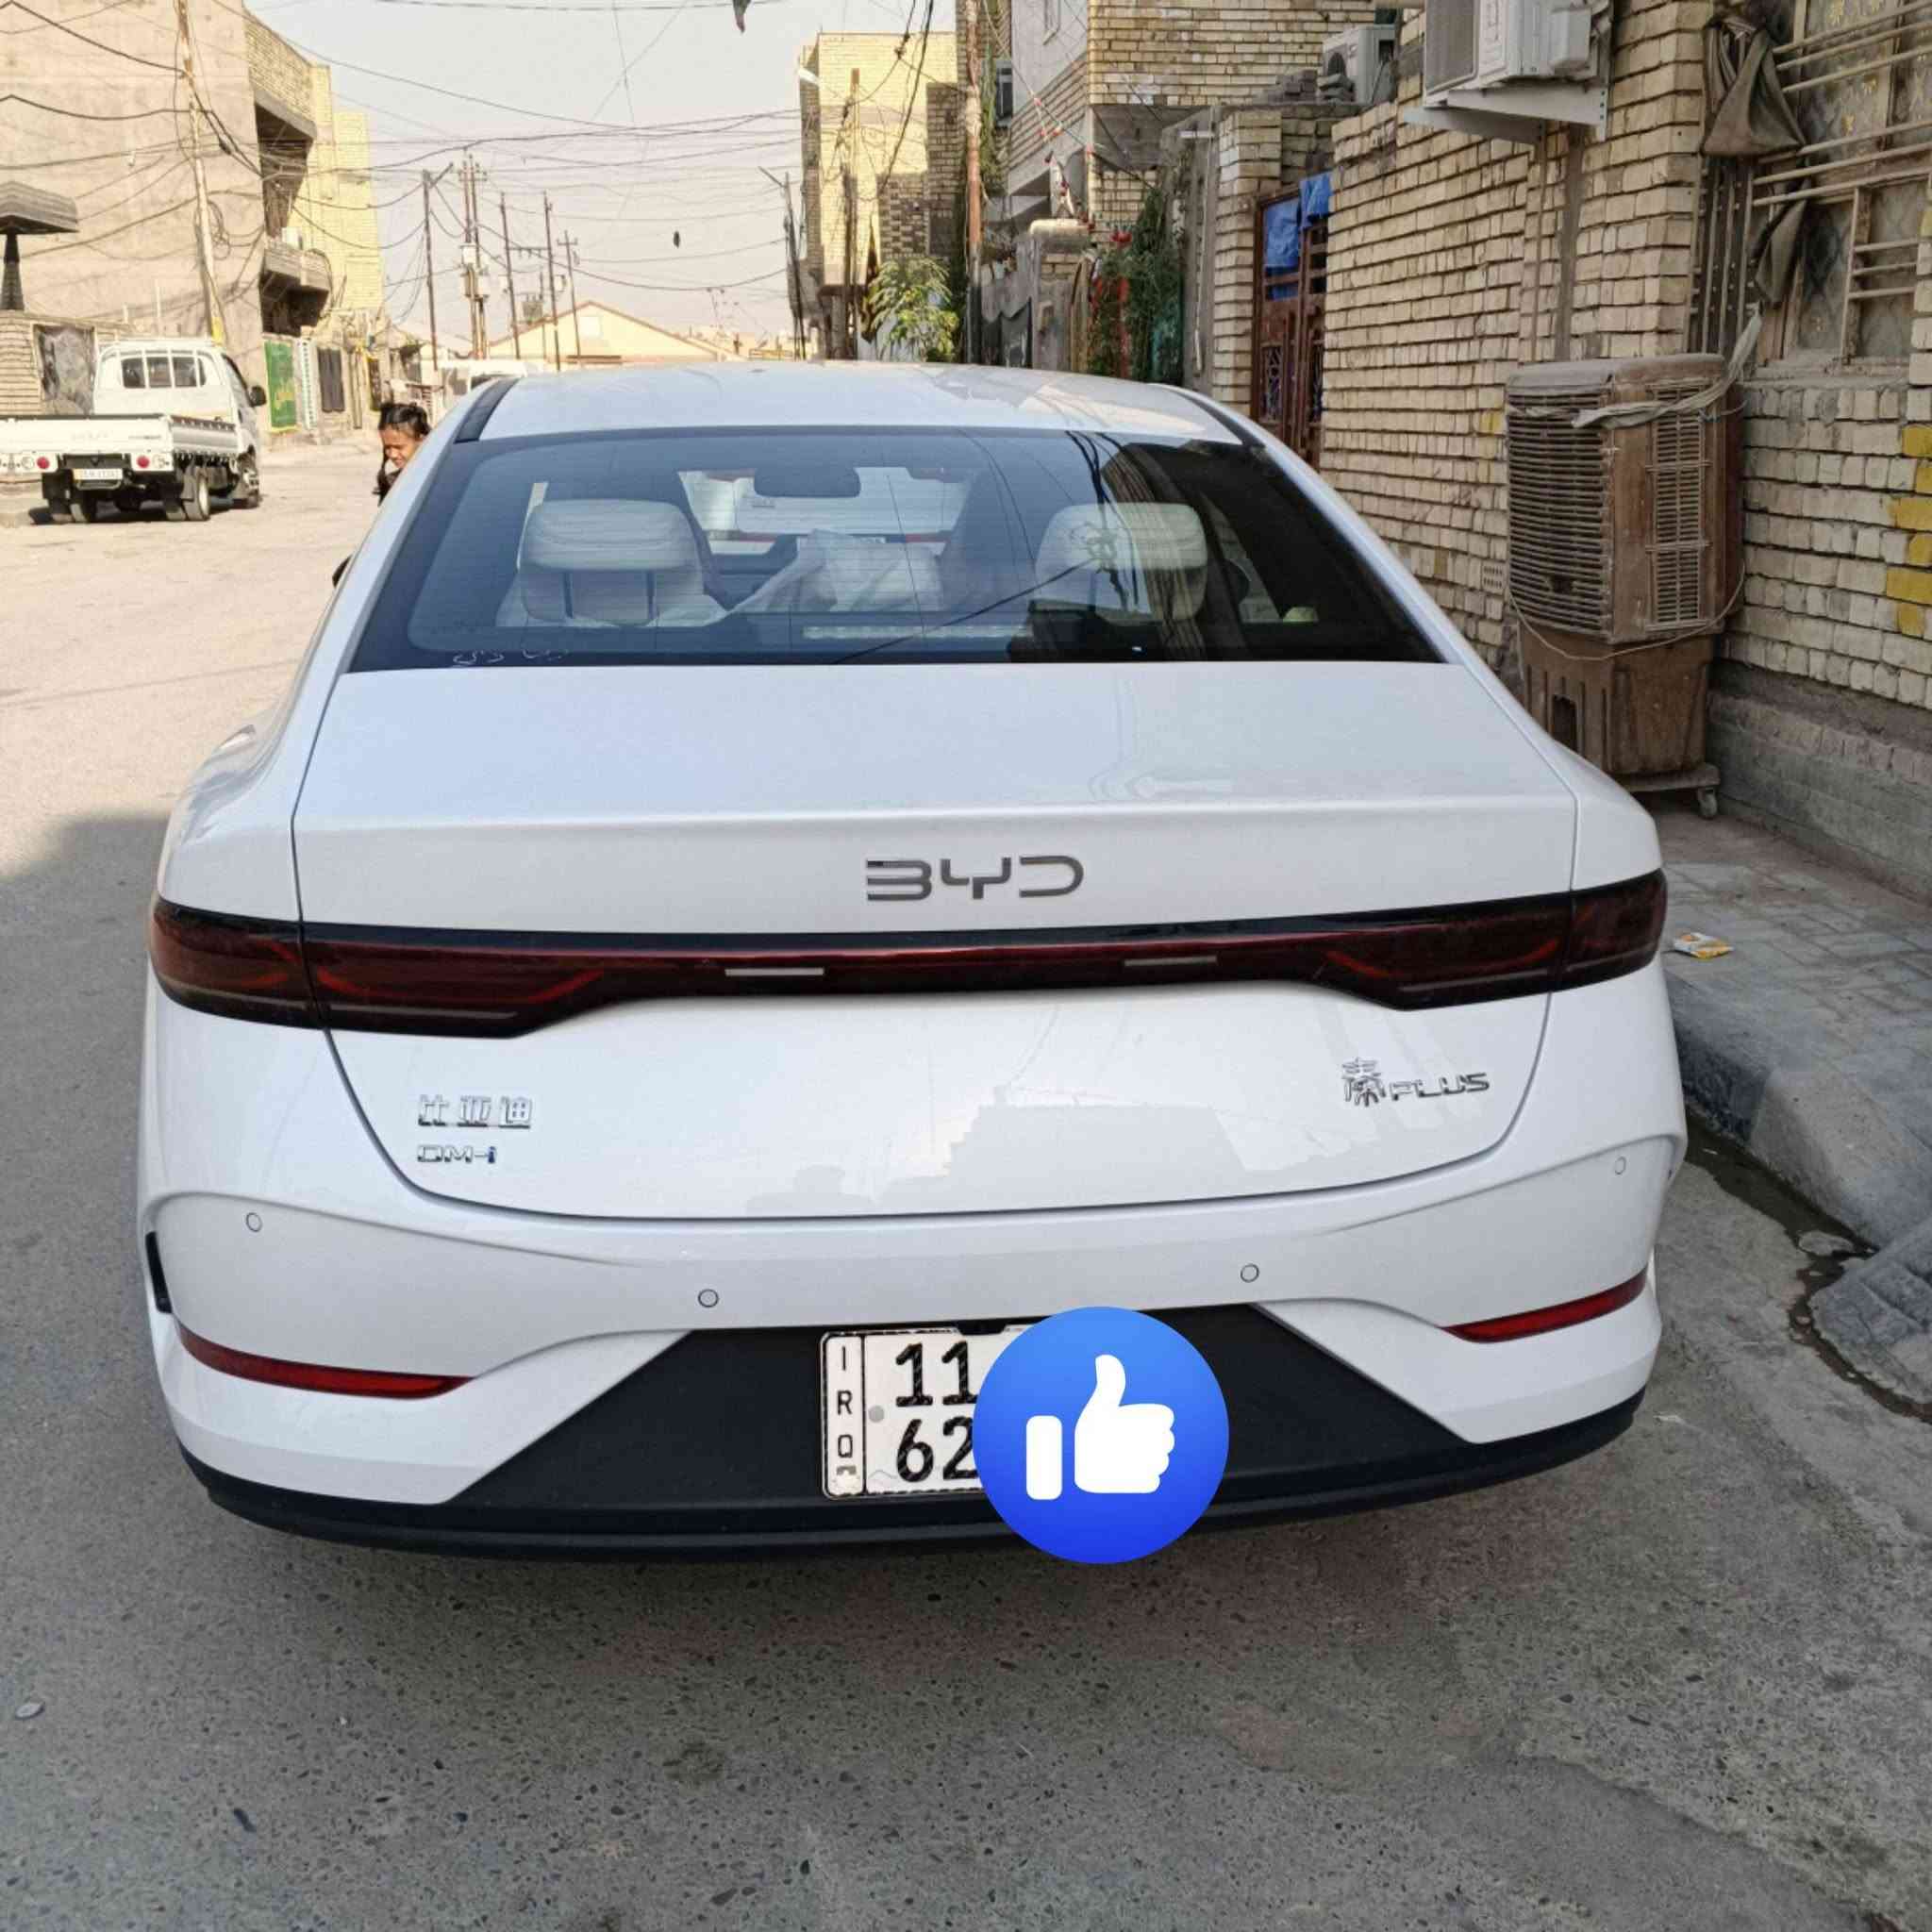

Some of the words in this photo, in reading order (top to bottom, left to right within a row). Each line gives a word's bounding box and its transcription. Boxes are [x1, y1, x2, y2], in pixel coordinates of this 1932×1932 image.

[866, 856, 1085, 901] BYD
[418, 1094, 532, 1129] 比亚迪
[417, 1143, 497, 1164] DM-i
